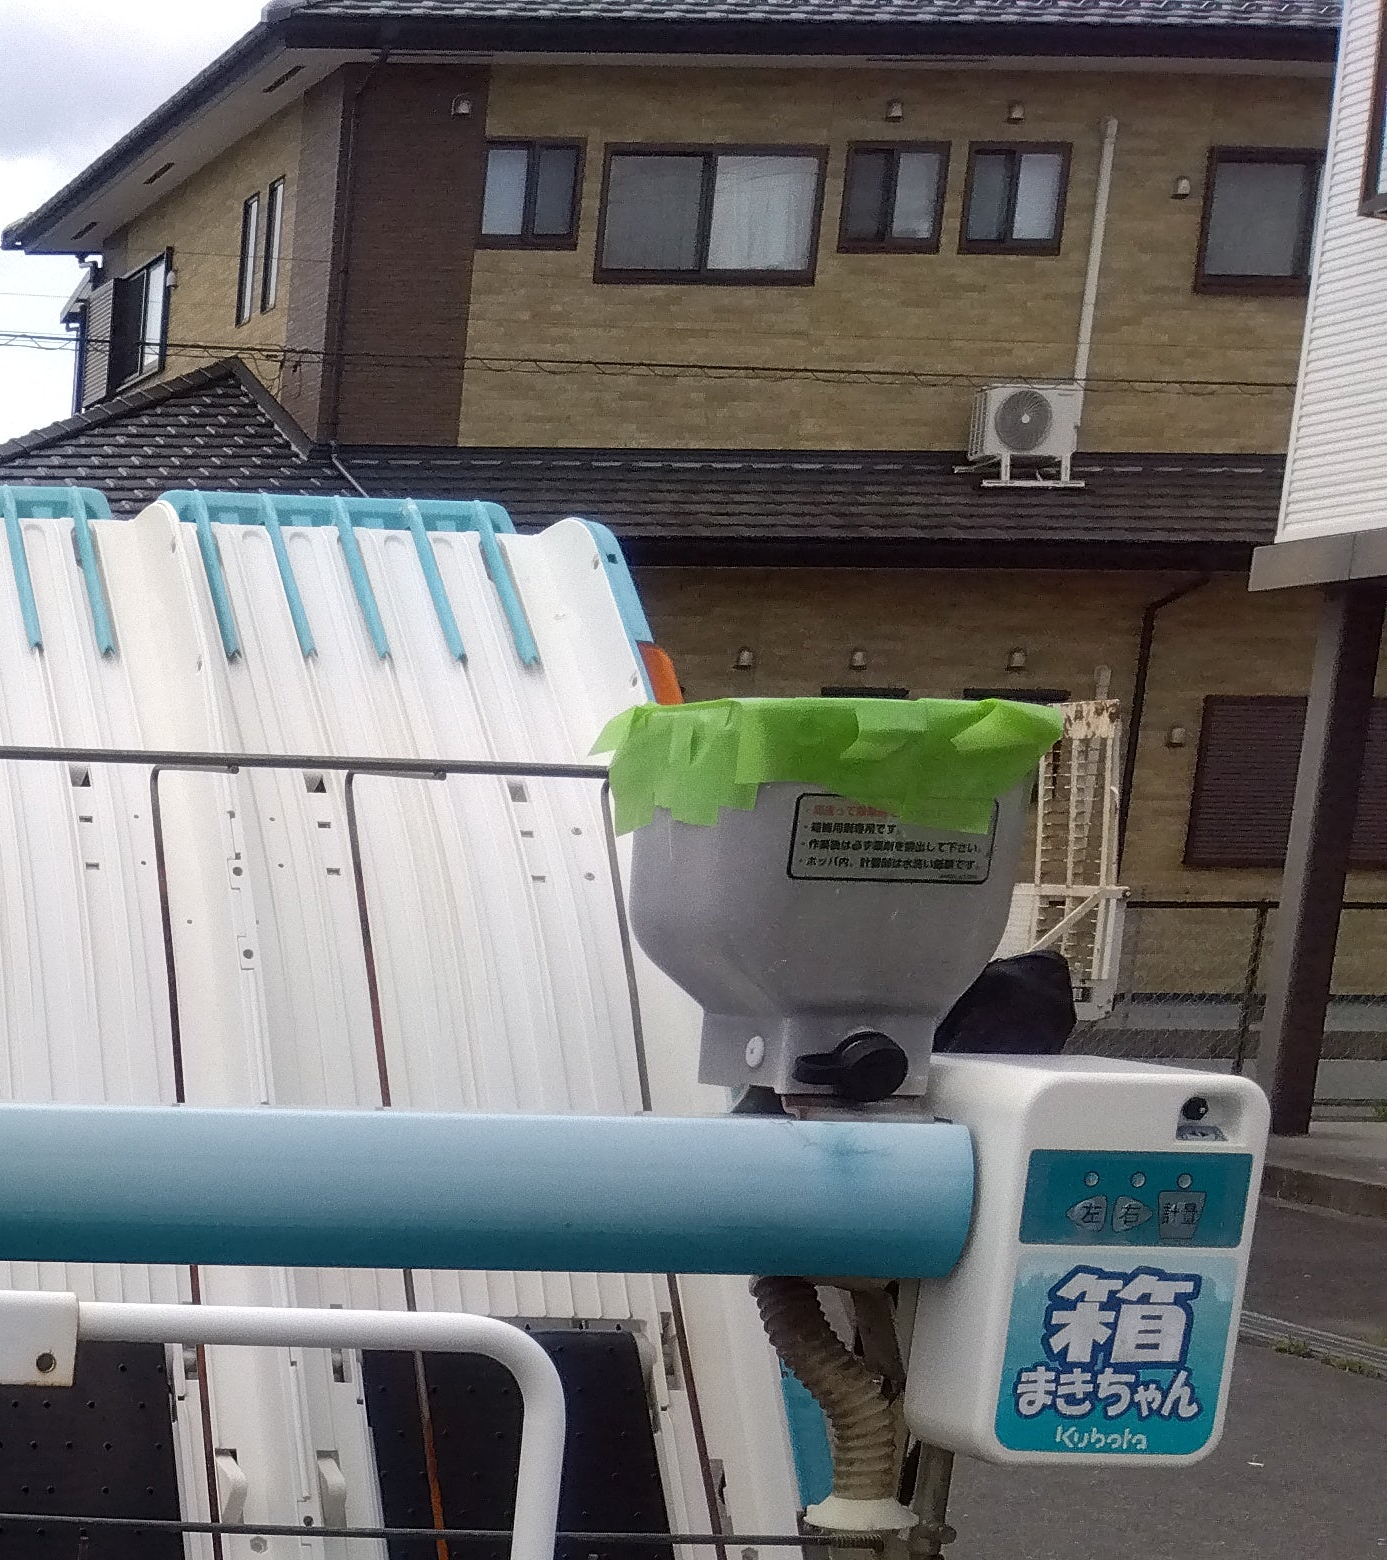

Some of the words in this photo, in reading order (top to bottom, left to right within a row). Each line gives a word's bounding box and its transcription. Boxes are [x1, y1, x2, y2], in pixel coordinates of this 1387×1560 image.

[1080, 1204, 1101, 1224] 左
[1118, 1204, 1141, 1226] 右
[1162, 1201, 1199, 1226] 計量
[1043, 1266, 1201, 1368] 箱
[1014, 1364, 1202, 1421] まきちゃん
[1054, 1424, 1148, 1450] Kubota
